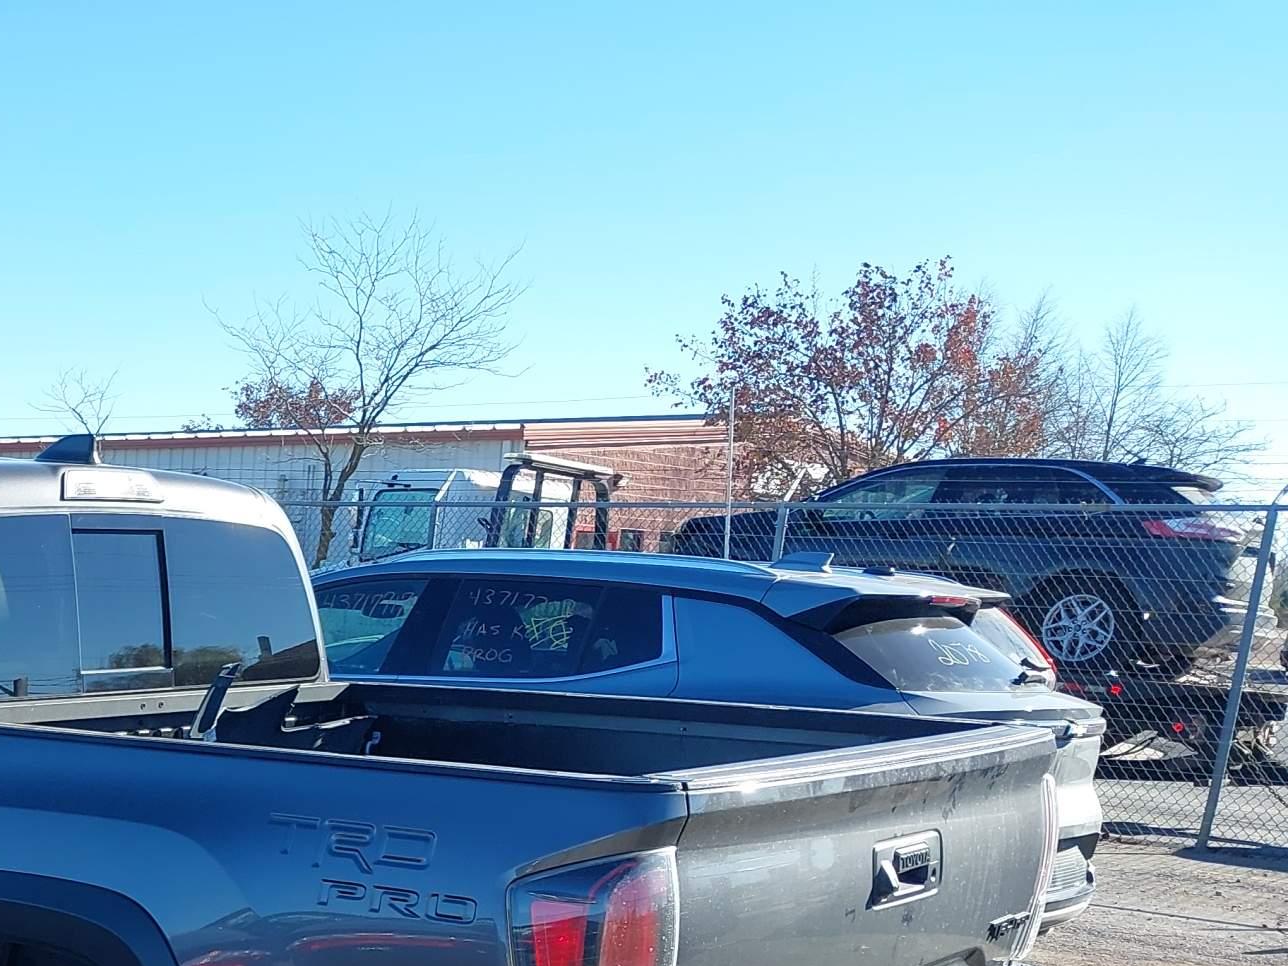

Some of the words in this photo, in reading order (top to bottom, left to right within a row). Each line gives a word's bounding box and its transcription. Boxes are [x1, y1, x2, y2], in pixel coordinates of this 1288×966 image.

[267, 812, 438, 875] TRD
[900, 848, 931, 870] TOYOTA
[316, 878, 479, 925] PRO
